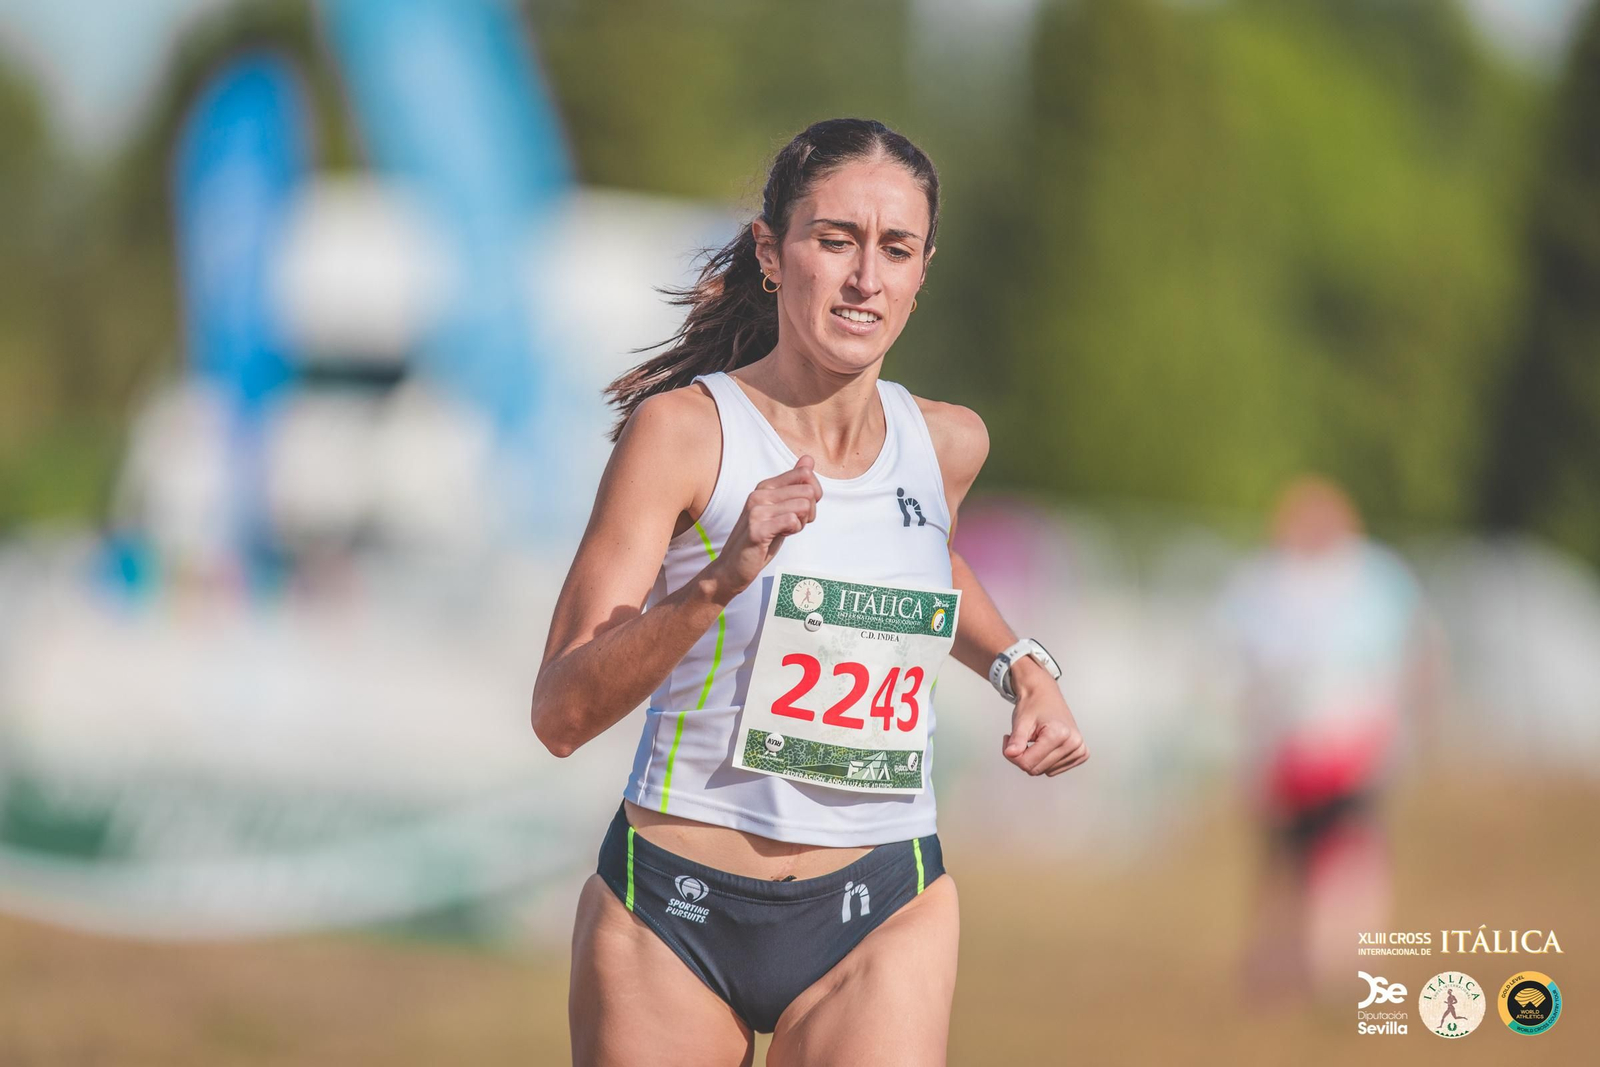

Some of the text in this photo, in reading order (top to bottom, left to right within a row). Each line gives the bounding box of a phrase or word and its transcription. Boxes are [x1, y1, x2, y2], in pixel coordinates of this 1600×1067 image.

[839, 587, 923, 619] ITÁLICA
[860, 630, 900, 643] C.D. INDEA
[770, 653, 924, 732] 2243
[783, 768, 826, 783] FEDERACIÓN
[828, 778, 862, 788] ANDALUZA
[665, 906, 706, 924] PURSUITS
[668, 898, 710, 916] SPORTING
